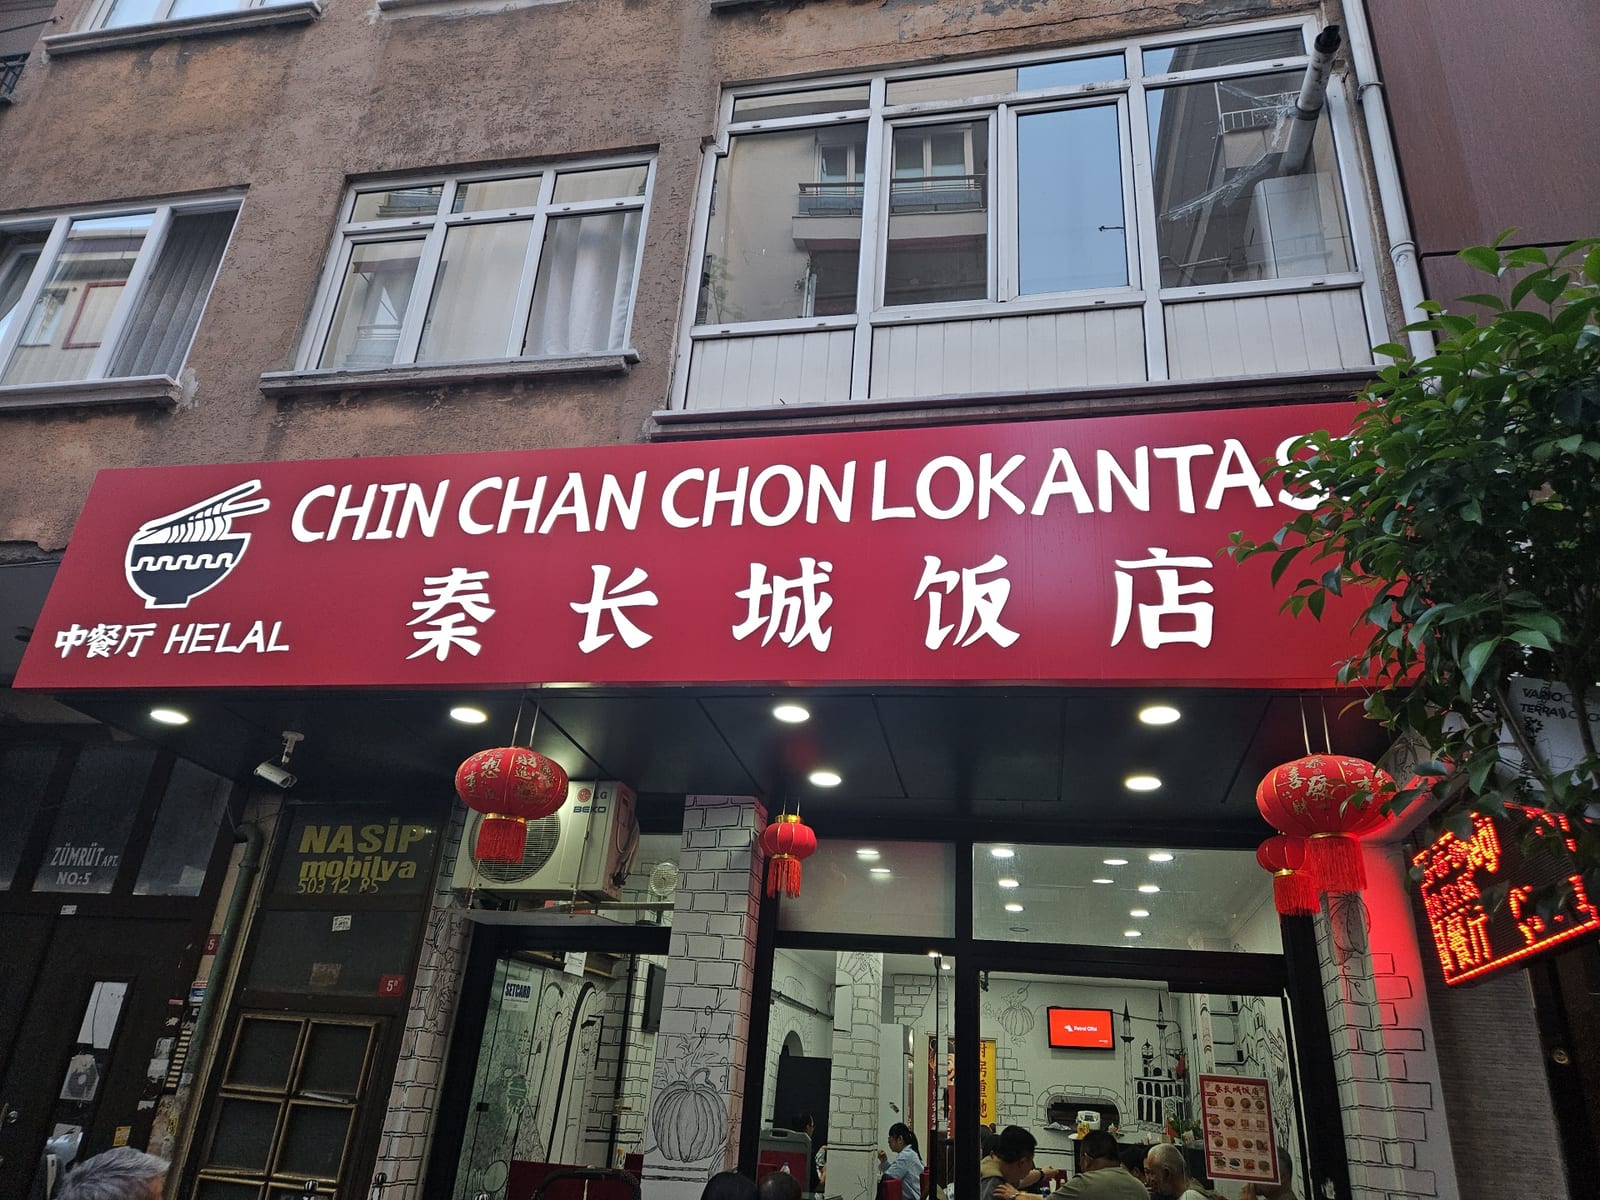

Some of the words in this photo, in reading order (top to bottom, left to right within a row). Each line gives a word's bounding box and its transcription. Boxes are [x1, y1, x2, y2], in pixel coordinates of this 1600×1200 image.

[290, 479, 450, 543] CHIN
[458, 470, 648, 535] CHAN
[660, 460, 857, 529] CHON
[871, 434, 1360, 521] LOKANTAS
[405, 546, 1214, 662] 秦长城饭店
[54, 622, 157, 659] 中餐厅
[162, 620, 290, 655] HELAL
[573, 805, 607, 814] BEKO
[299, 817, 426, 854] NASİP
[51, 842, 105, 867] ZÜMRÜT
[55, 871, 92, 886] NO:5
[299, 856, 417, 882] mobilya
[297, 877, 326, 894] 503
[331, 876, 351, 894] 12
[207, 938, 216, 951] 5
[505, 981, 531, 999] SETCARD
